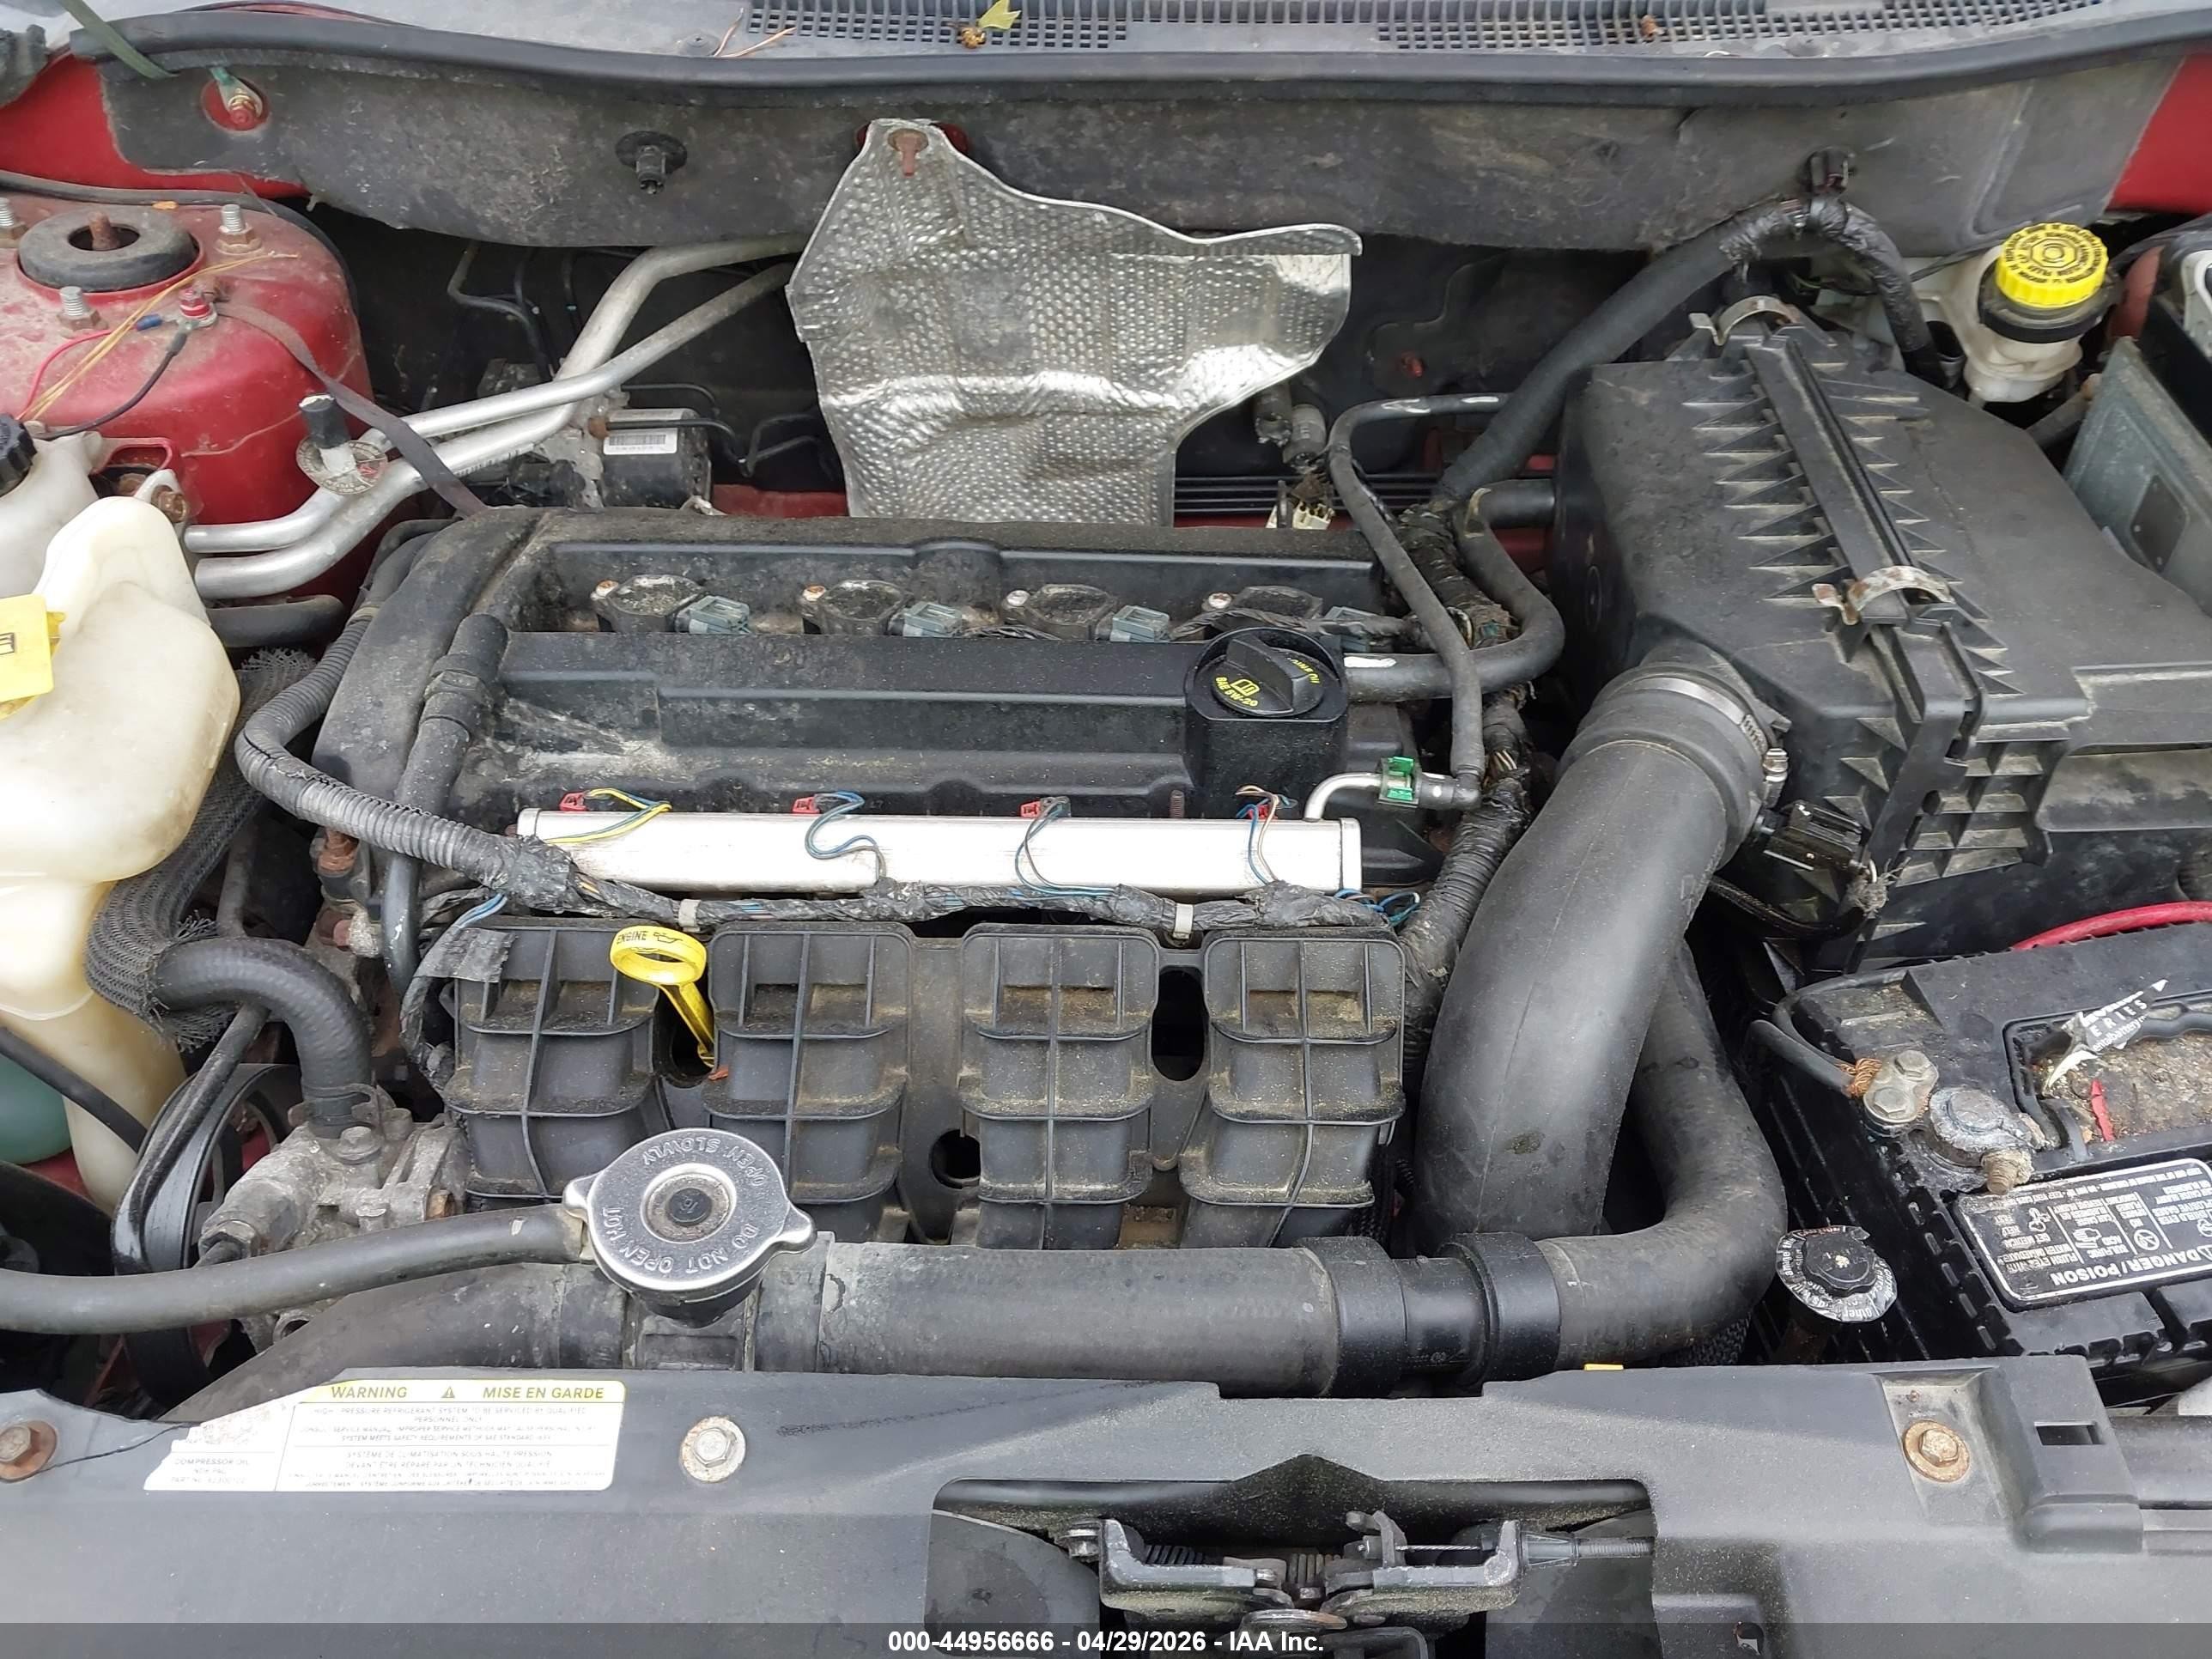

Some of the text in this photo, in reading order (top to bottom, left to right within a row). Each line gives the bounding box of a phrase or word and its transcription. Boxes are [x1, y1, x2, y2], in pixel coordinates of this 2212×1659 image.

[1224, 690, 1260, 708] 5W-20
[616, 930, 648, 945] ENGINE
[642, 1136, 721, 1165] SLOWLY
[2002, 1225, 2021, 1237] HELP
[602, 1206, 760, 1275] DO NOT OPEN HOT
[2002, 1232, 2051, 1249] GET MEDICAL
[2101, 1236, 2123, 1246] ACID
[2045, 1243, 2073, 1255] WATER
[2087, 1243, 2130, 1259] SULFURIC
[1782, 1250, 1795, 1276] amage
[2050, 1252, 2079, 1265] FLUSH
[2050, 1249, 2203, 1286] DANGER/POISON
[1842, 1306, 1873, 1319] Other
[331, 1386, 408, 1399] WARNING
[483, 1387, 605, 1399] MISE EN GARDE
